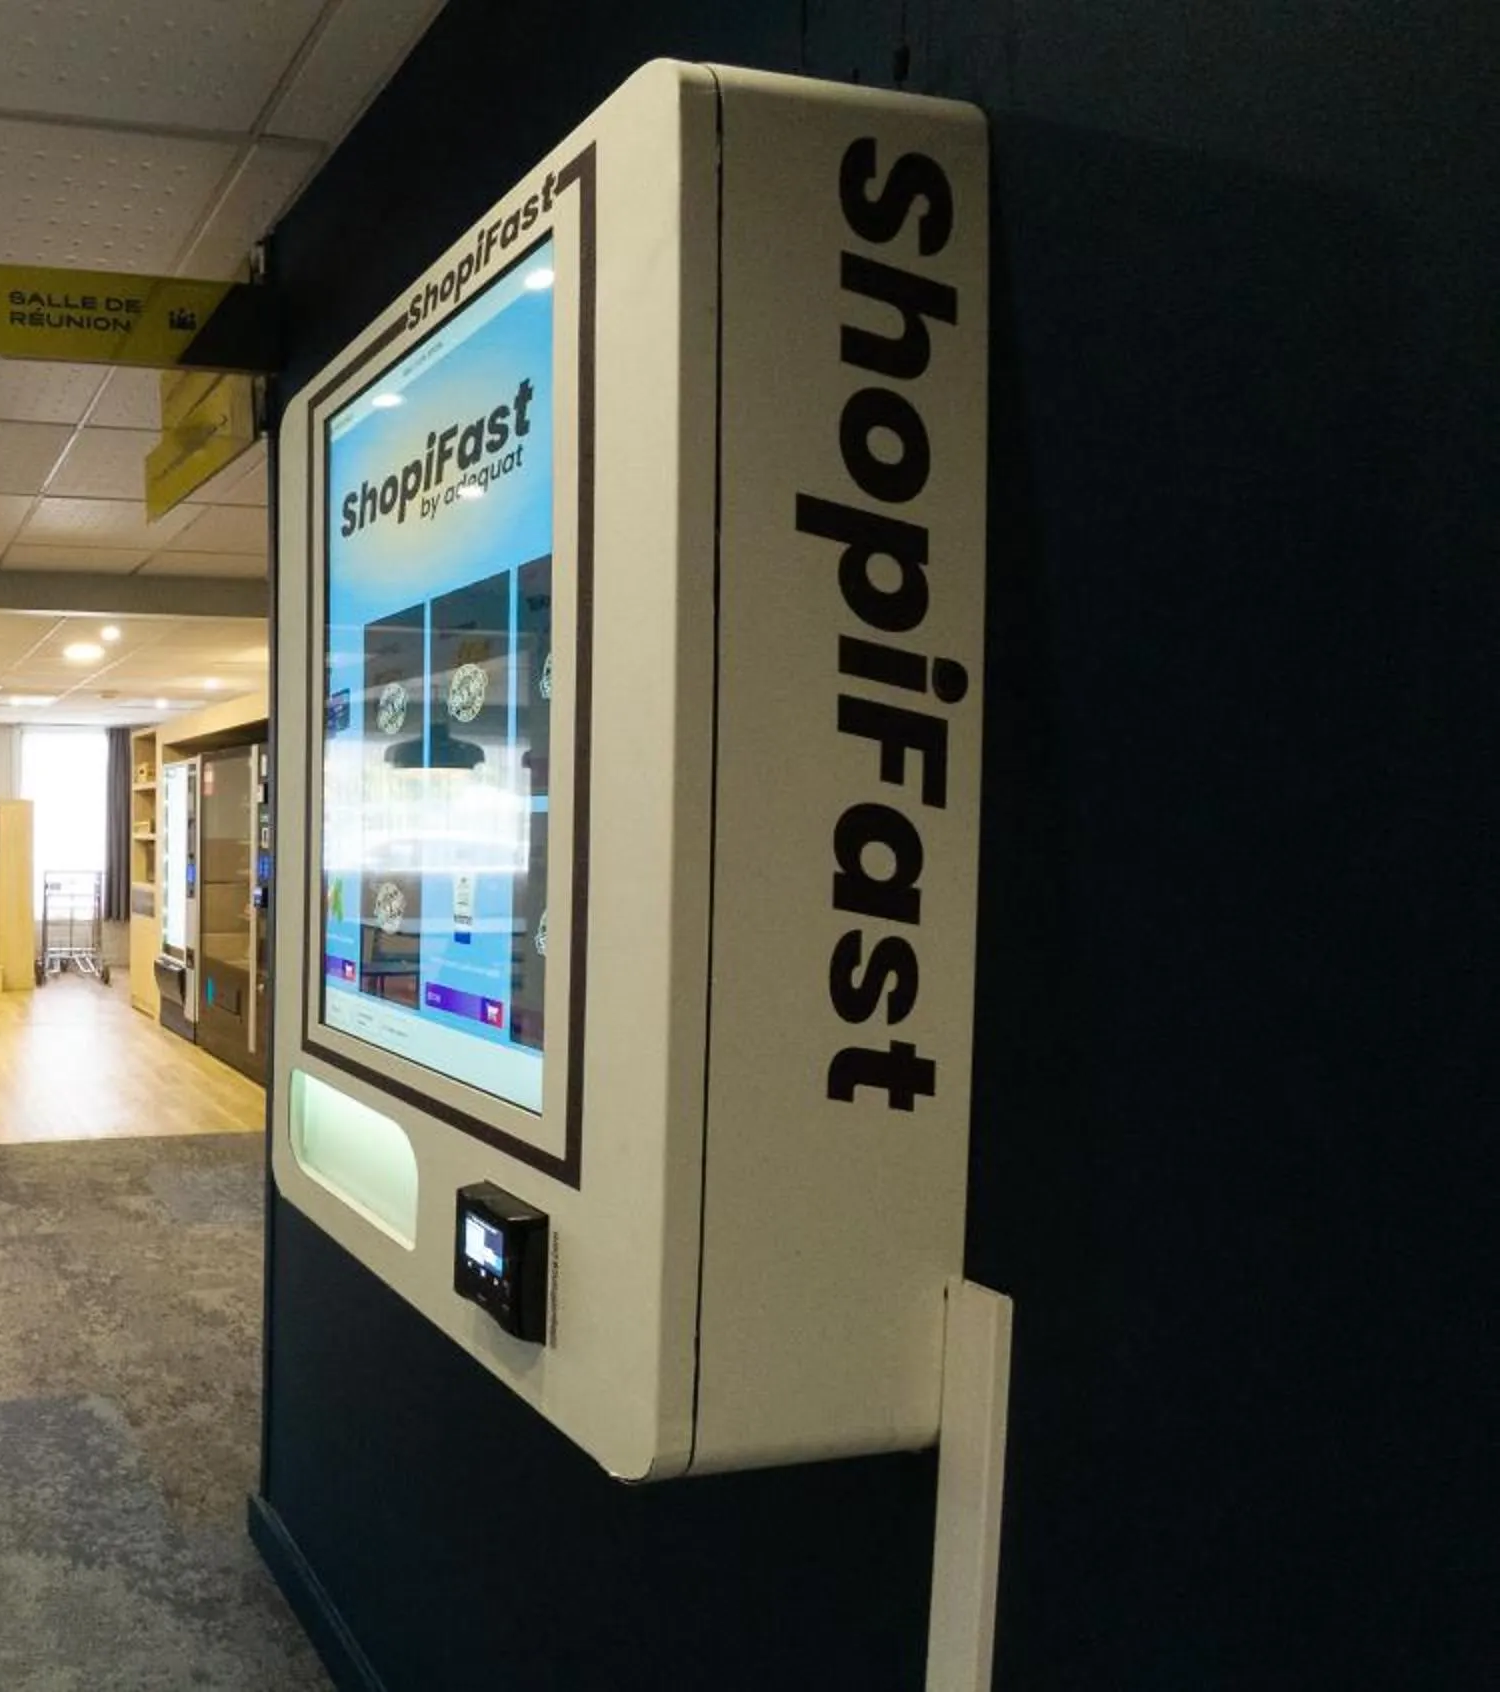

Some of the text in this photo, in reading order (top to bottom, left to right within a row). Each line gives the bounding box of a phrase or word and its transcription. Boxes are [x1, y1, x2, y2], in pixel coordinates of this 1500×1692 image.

[408, 171, 556, 331] ShopiFast
[9, 291, 142, 313] SALLE DE
[9, 308, 132, 332] RÉUNION
[341, 378, 534, 538] ShopiFast
[420, 493, 441, 521] by
[795, 136, 969, 1112] ShopiFast
